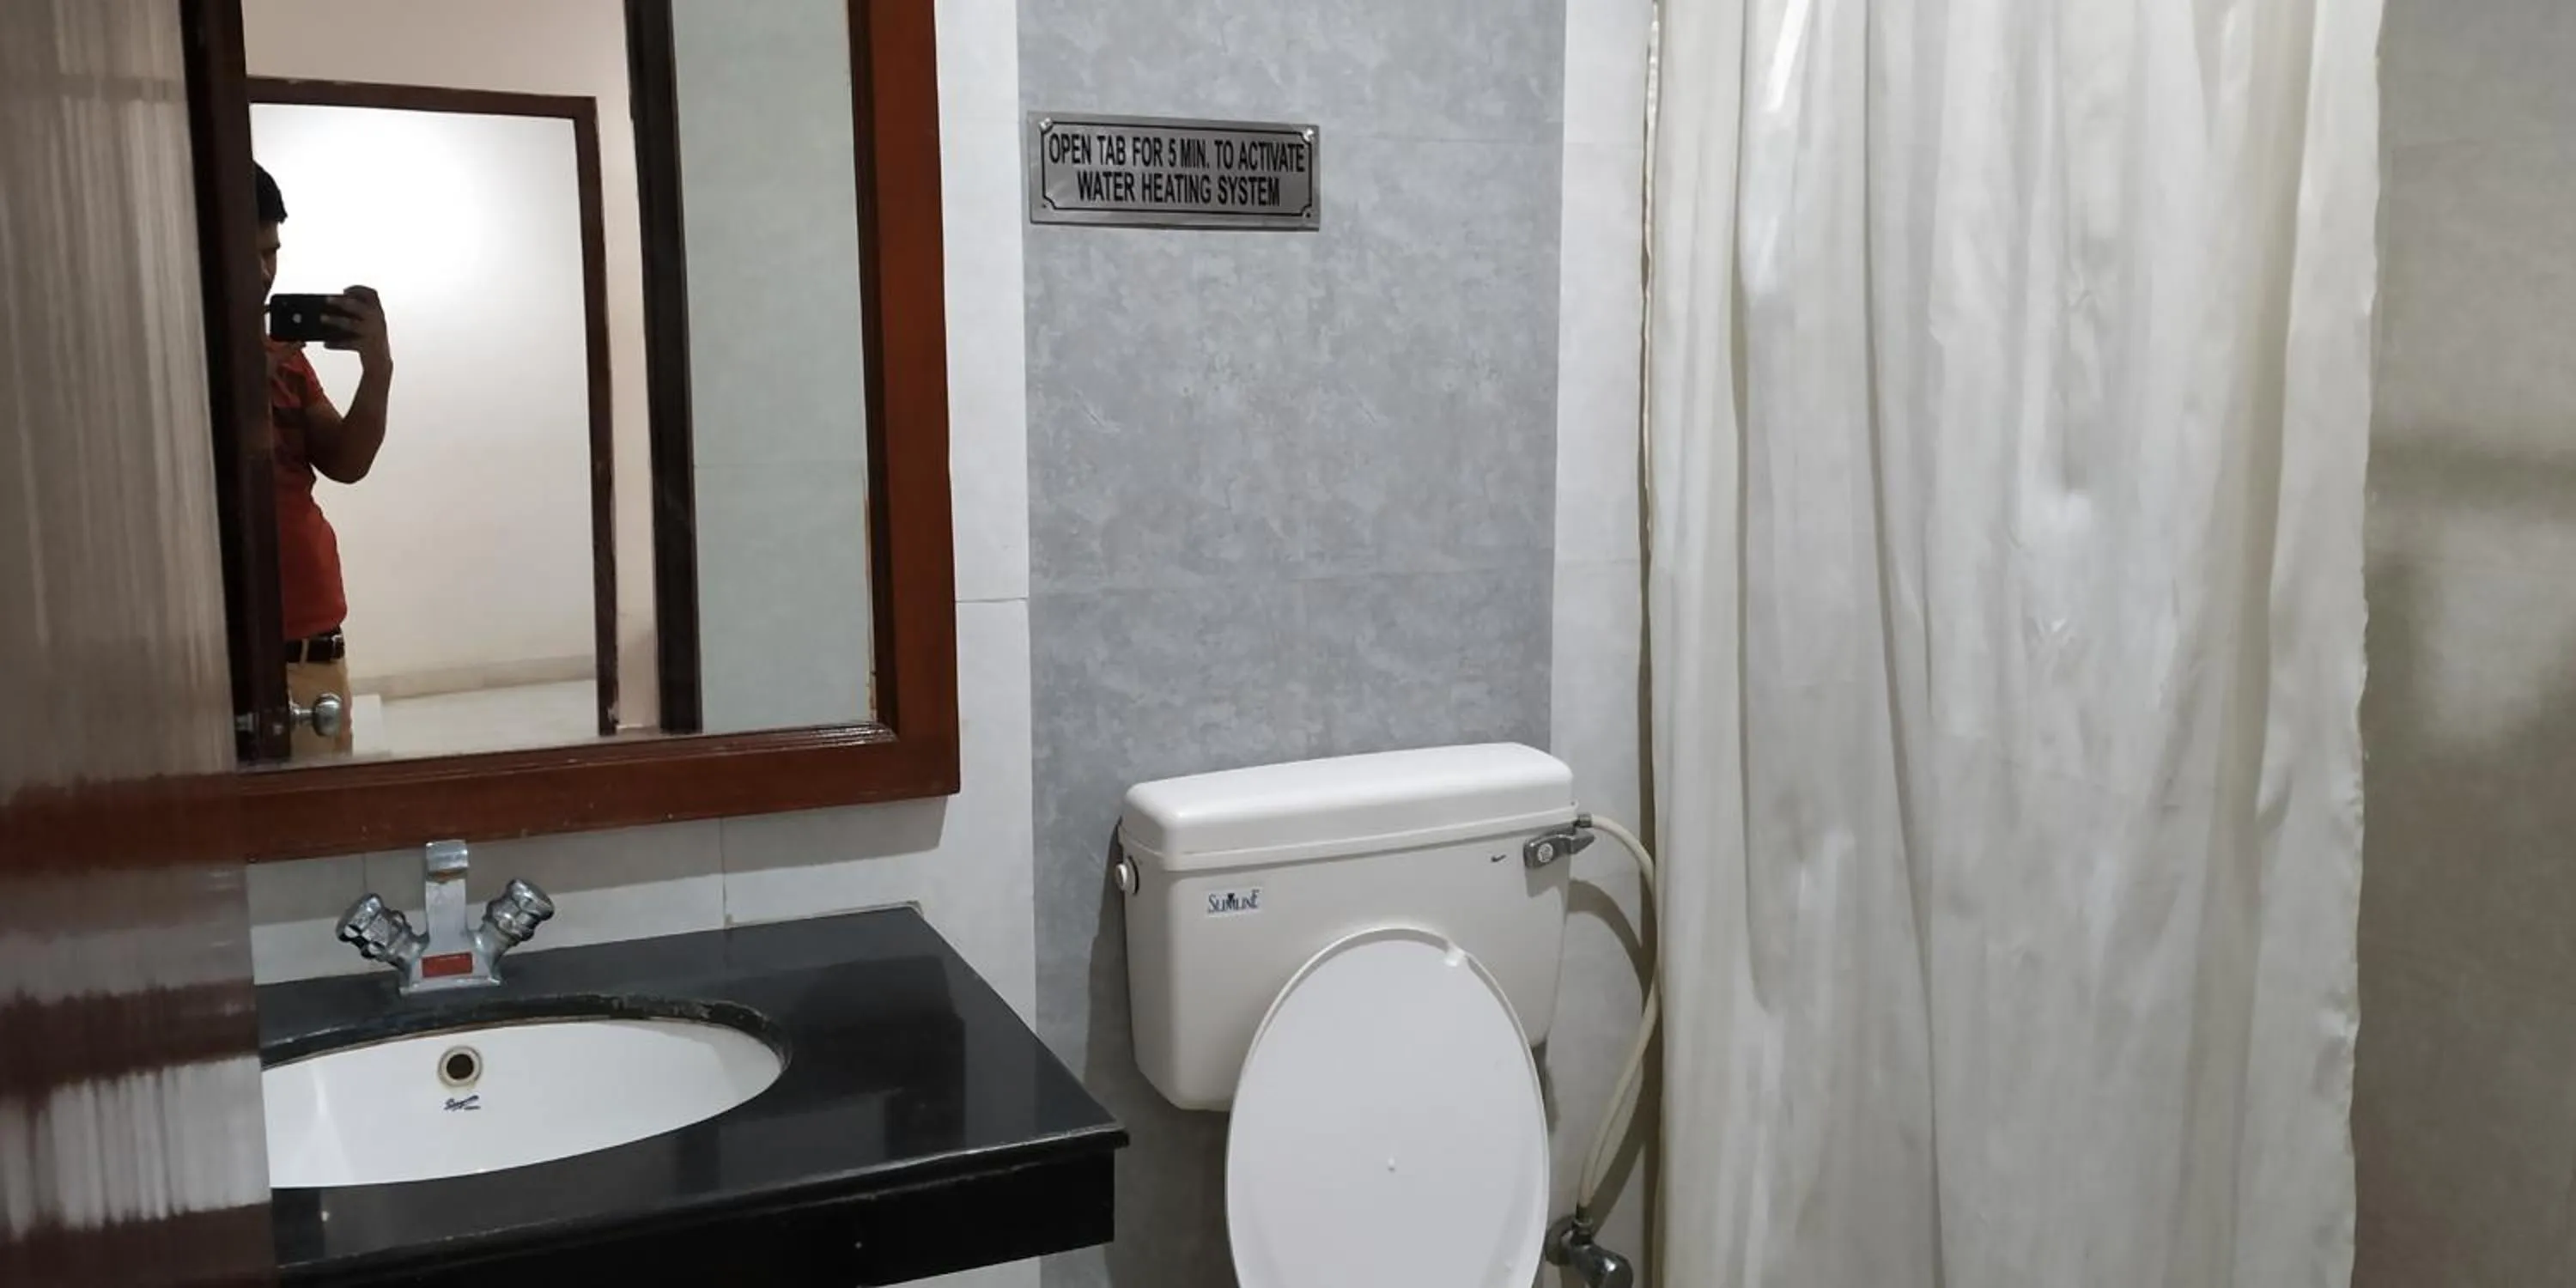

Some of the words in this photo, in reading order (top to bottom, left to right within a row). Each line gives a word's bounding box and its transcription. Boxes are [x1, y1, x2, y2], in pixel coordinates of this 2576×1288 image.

[1048, 133, 1091, 165] OPEN
[1097, 135, 1127, 166] TAB
[1132, 137, 1163, 167] FOR
[1168, 139, 1176, 167] 5
[1180, 139, 1210, 169] MIN.
[1214, 141, 1234, 171] TO
[1239, 141, 1305, 172] ACTIVATE
[1077, 171, 1135, 203] WATER
[1141, 173, 1212, 204] HEATING
[1217, 175, 1281, 206] SYSTEM
